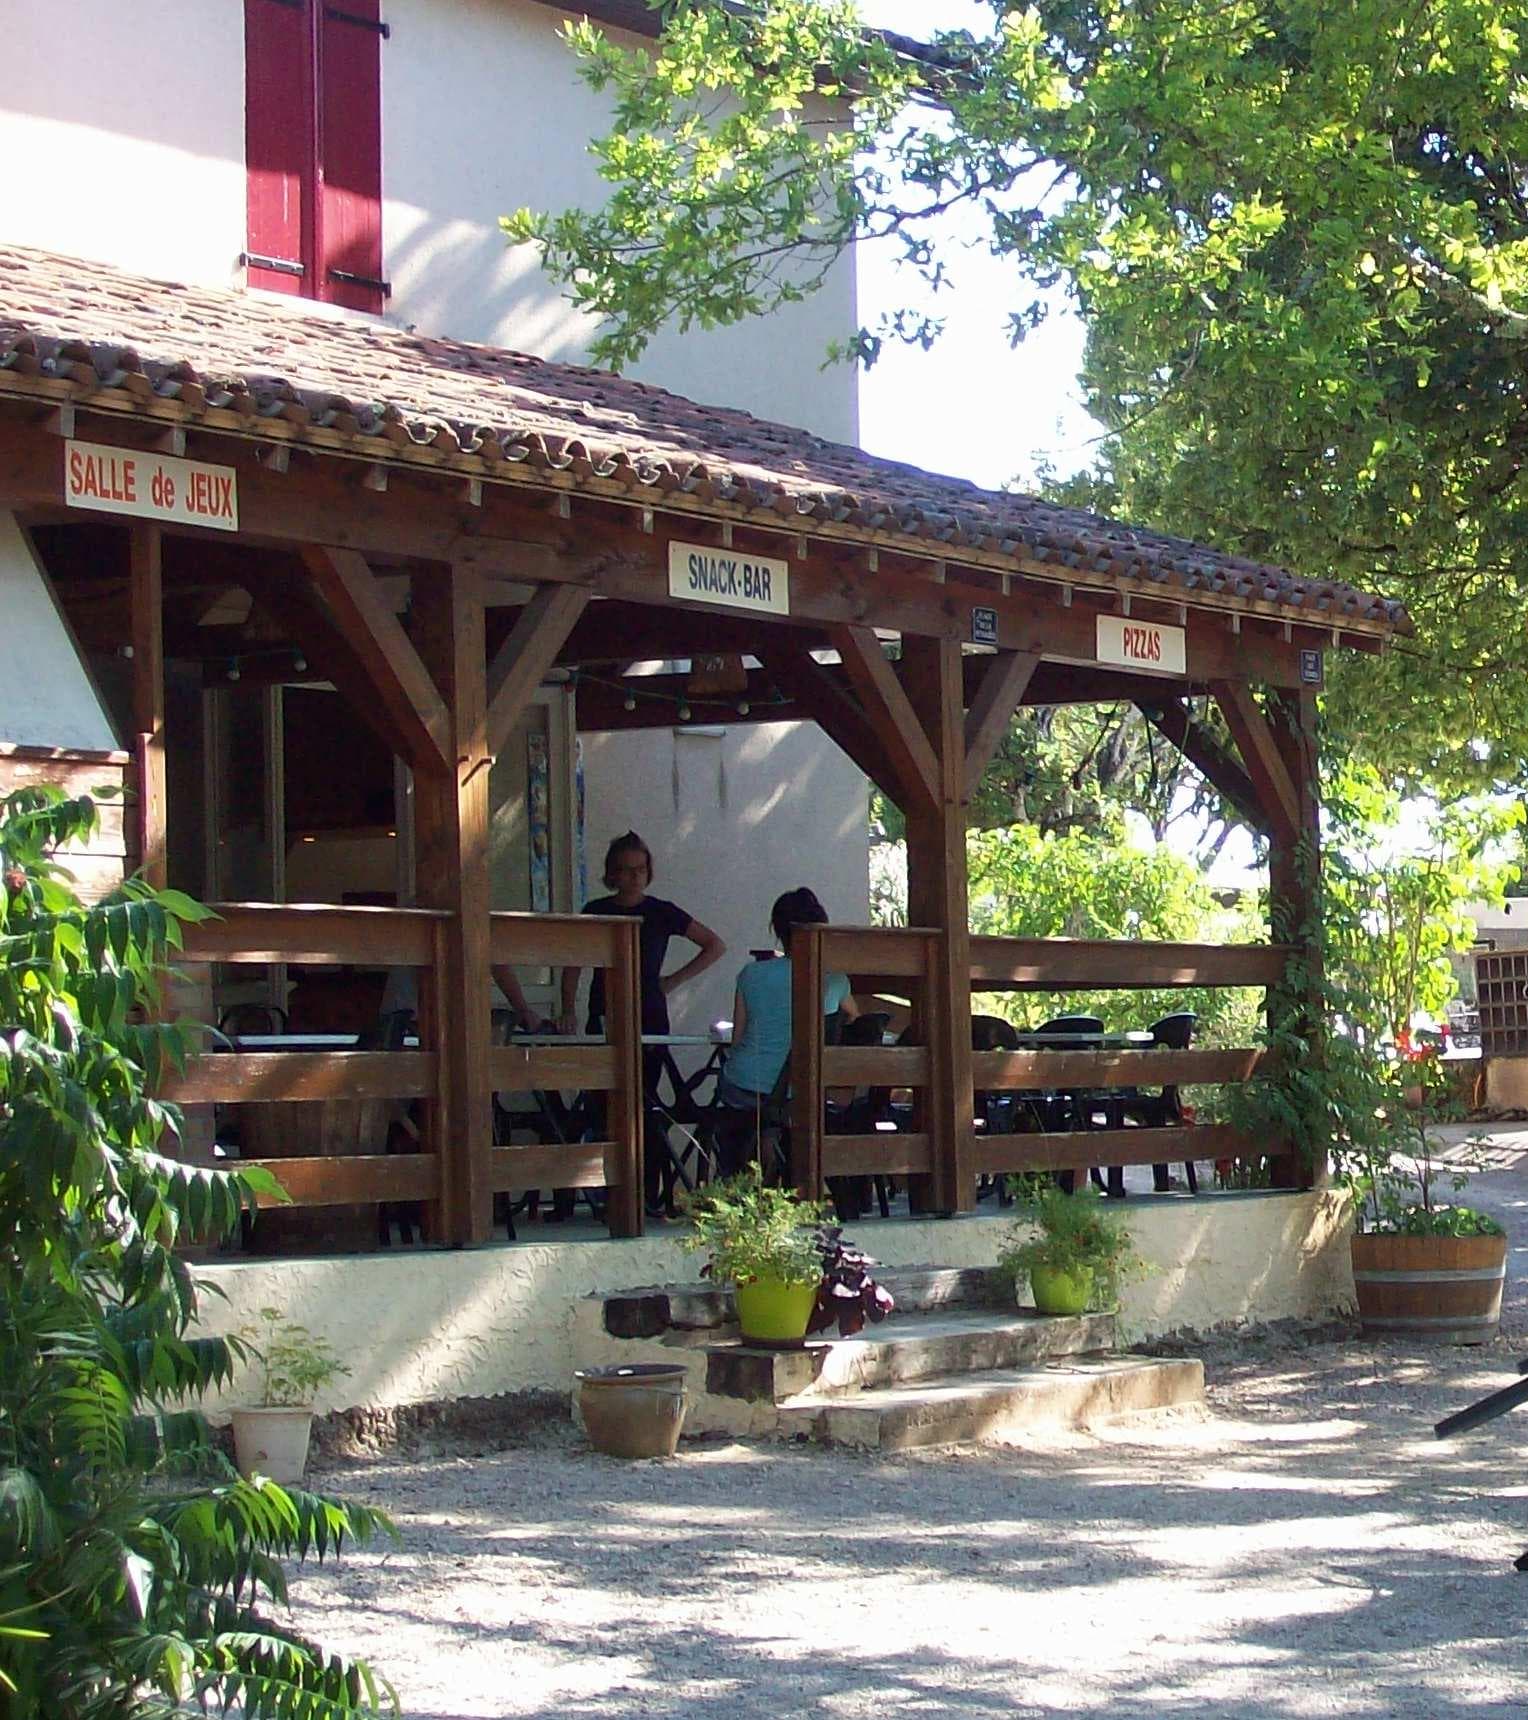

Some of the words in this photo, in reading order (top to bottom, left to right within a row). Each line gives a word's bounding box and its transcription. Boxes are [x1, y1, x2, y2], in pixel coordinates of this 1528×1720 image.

[70, 450, 137, 502] SALLE
[152, 465, 175, 510] de
[185, 472, 233, 518] JEUX
[1123, 626, 1161, 662] PIZZAS
